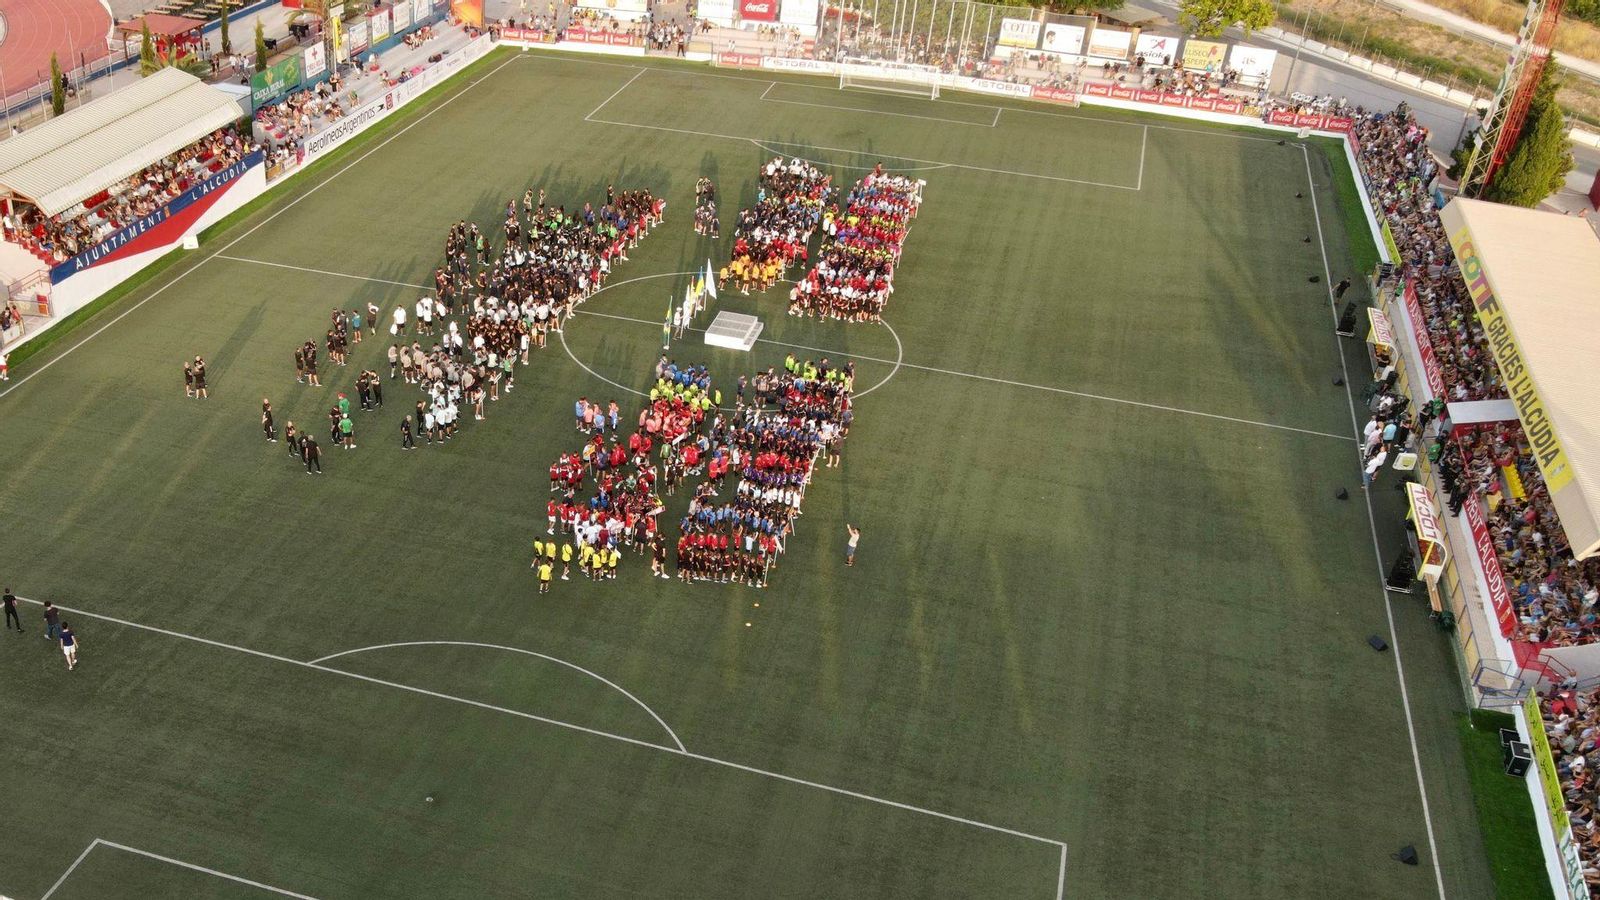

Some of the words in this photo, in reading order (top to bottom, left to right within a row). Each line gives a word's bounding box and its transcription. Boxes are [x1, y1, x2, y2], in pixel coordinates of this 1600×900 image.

[744, 2, 769, 13] Coca-Cola
[75, 211, 162, 270] AJUNTAMENT
[192, 161, 248, 200] L'ALCUDIA
[1458, 241, 1500, 312] COTIF
[1414, 487, 1437, 539] LOCAL
